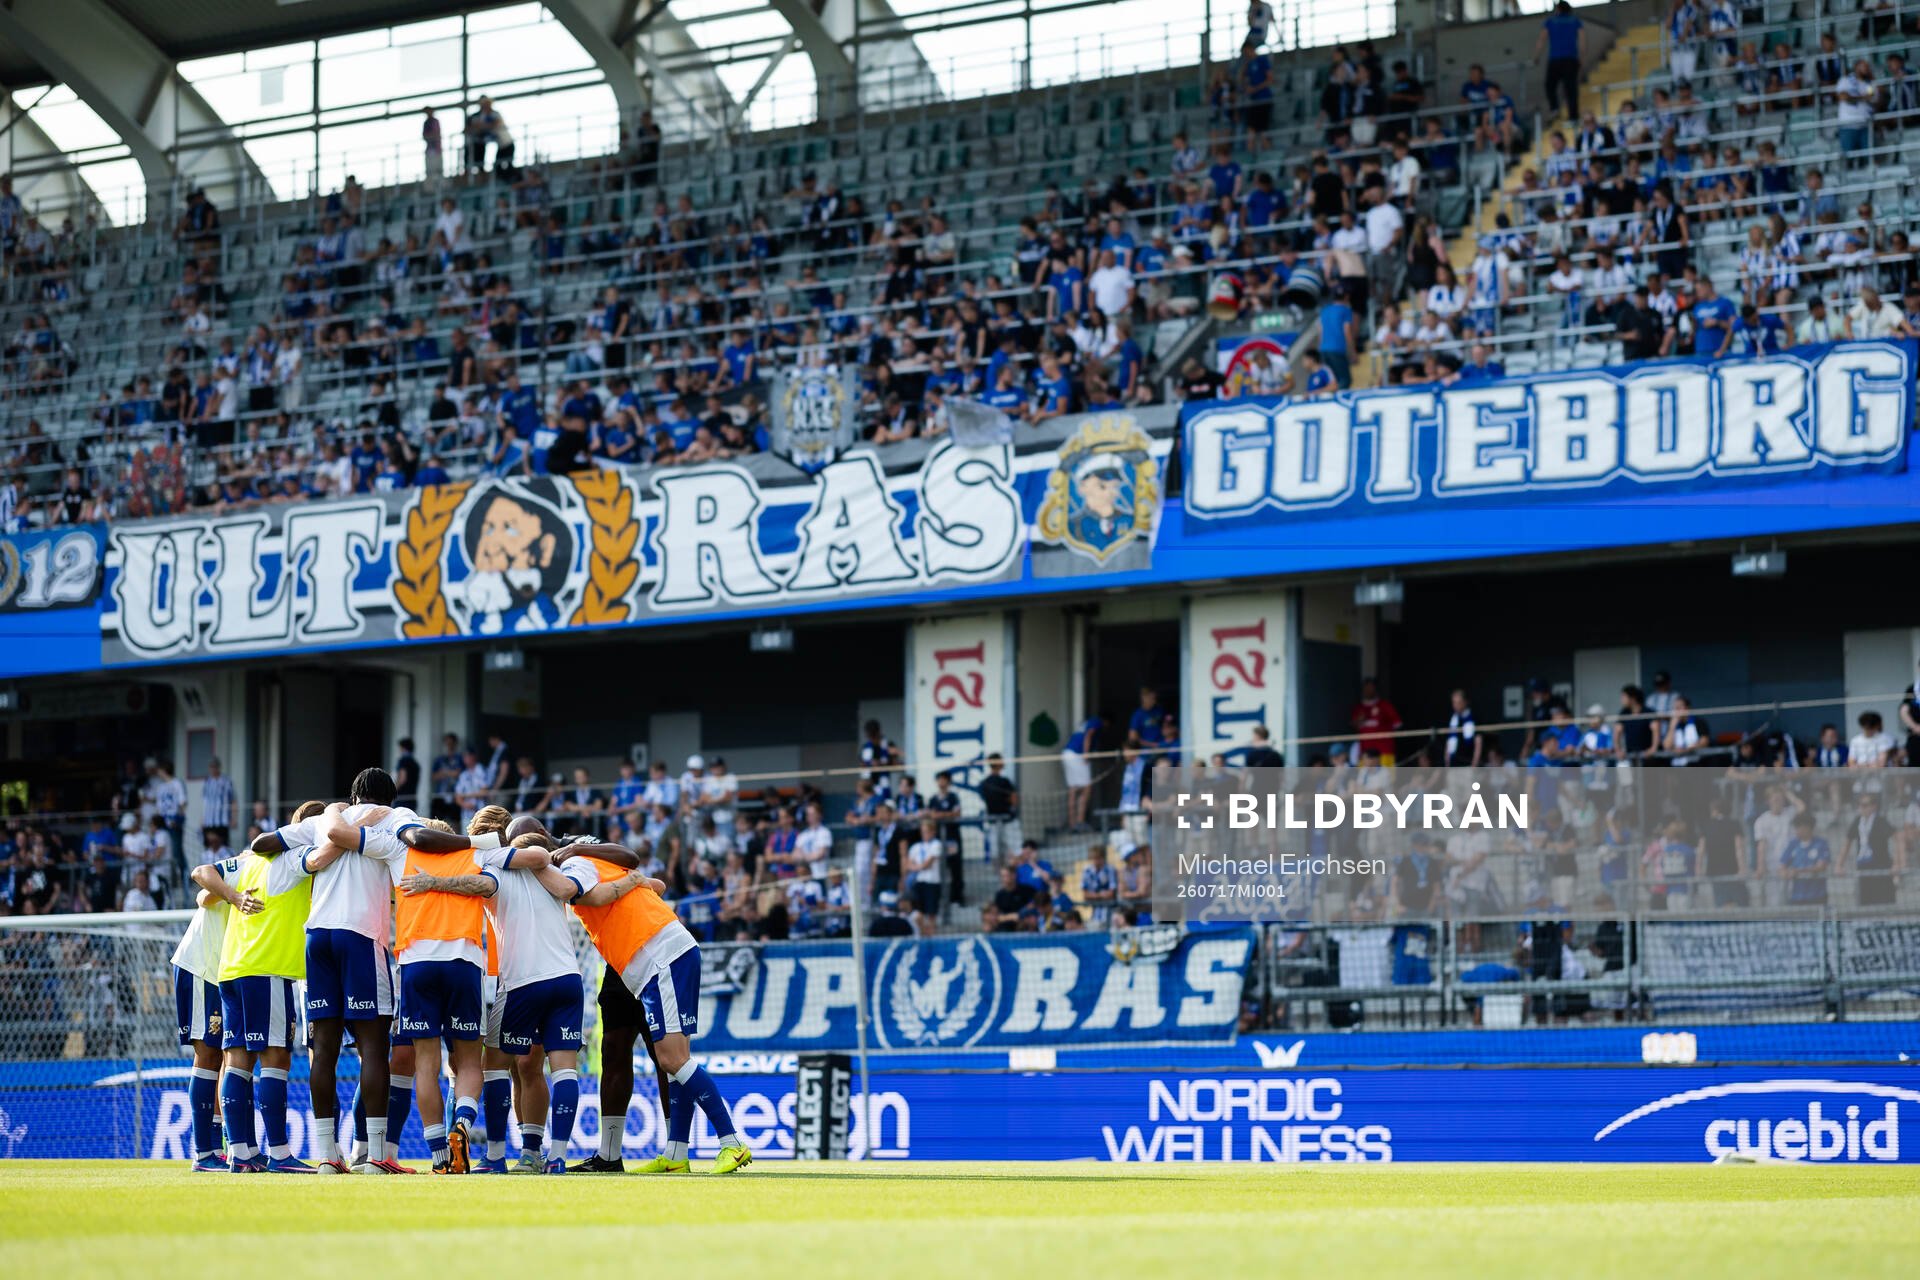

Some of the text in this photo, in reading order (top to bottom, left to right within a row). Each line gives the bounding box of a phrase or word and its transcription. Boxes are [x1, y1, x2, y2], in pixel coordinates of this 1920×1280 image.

[652, 441, 1020, 607] RAS
[17, 531, 98, 607] 12
[1000, 940, 1250, 1033] RAS
[307, 999, 329, 1010] ASTA
[348, 1000, 376, 1010] RASTA
[402, 1021, 430, 1031] RASTA
[451, 1021, 478, 1031] RASTA
[504, 1036, 533, 1046] RASTA
[562, 1031, 581, 1040] RAST
[1148, 1077, 1343, 1122] NORDIC
[1704, 1101, 1899, 1161] cuebid
